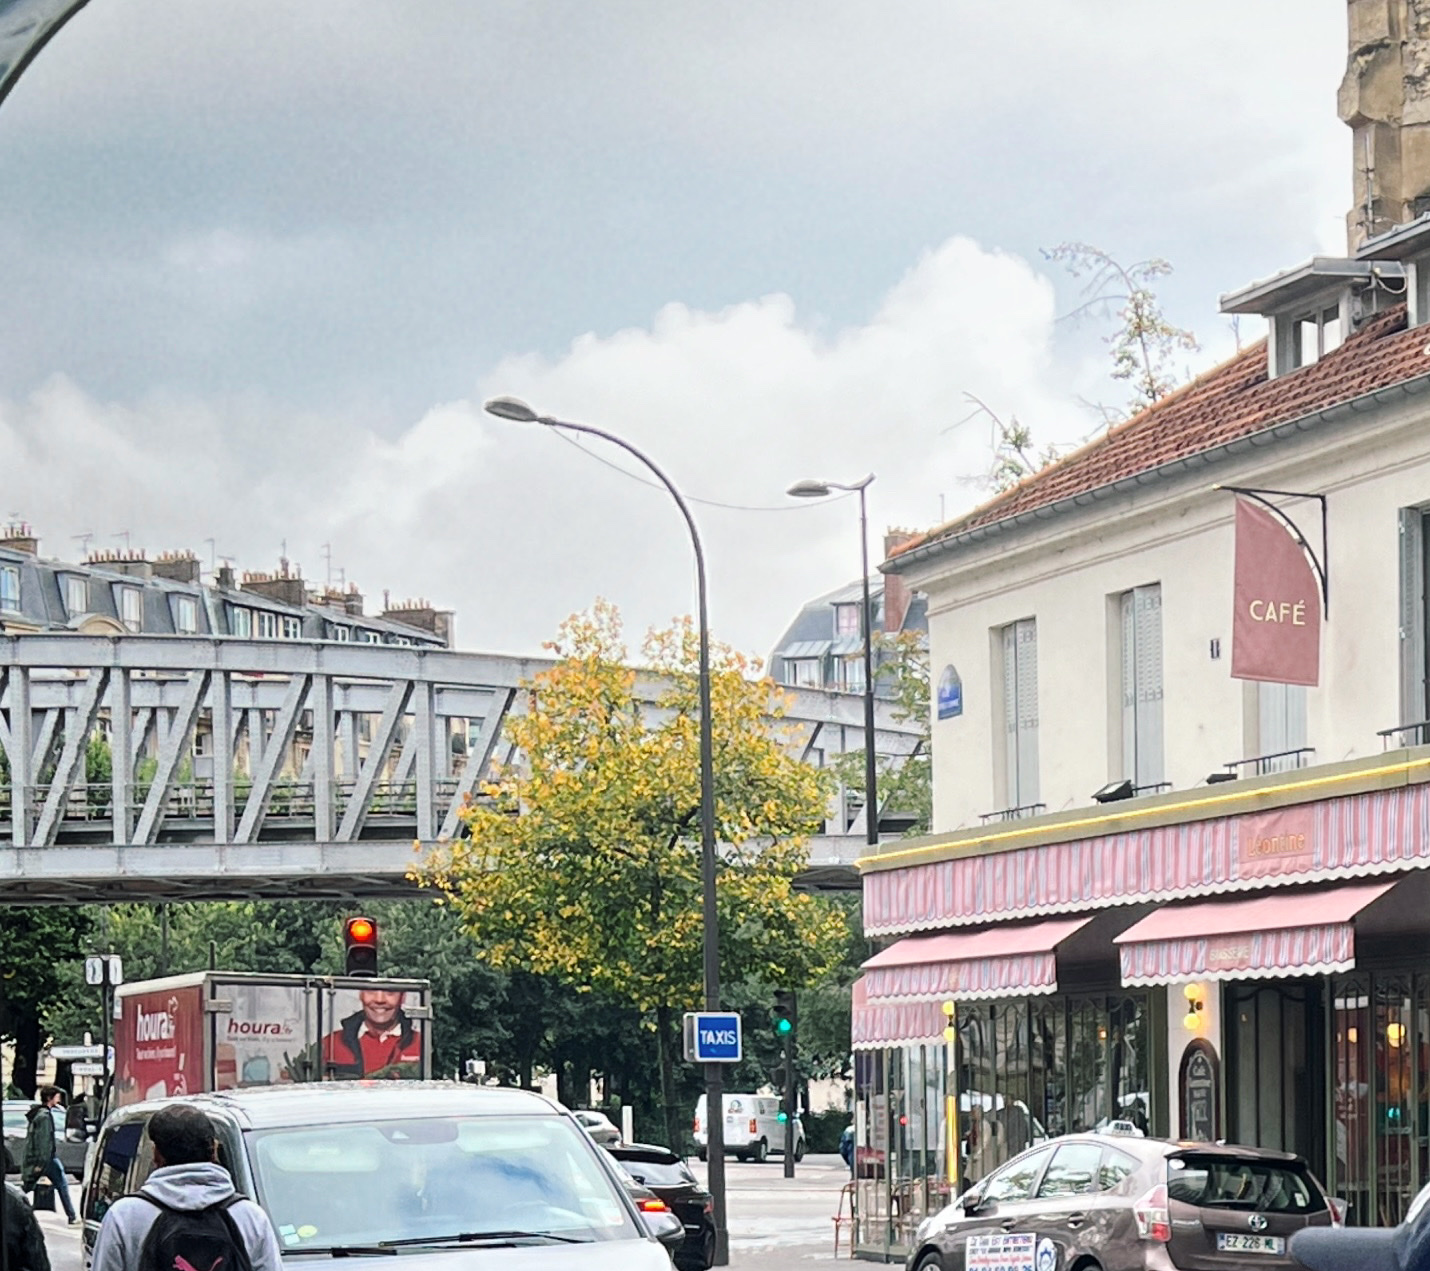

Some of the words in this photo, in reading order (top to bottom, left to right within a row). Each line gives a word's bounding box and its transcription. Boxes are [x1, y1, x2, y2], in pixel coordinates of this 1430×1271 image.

[1249, 600, 1306, 625] CAFÉ
[136, 1004, 171, 1042] houra
[227, 1018, 281, 1035] houra
[700, 1030, 737, 1045] TAXIS
